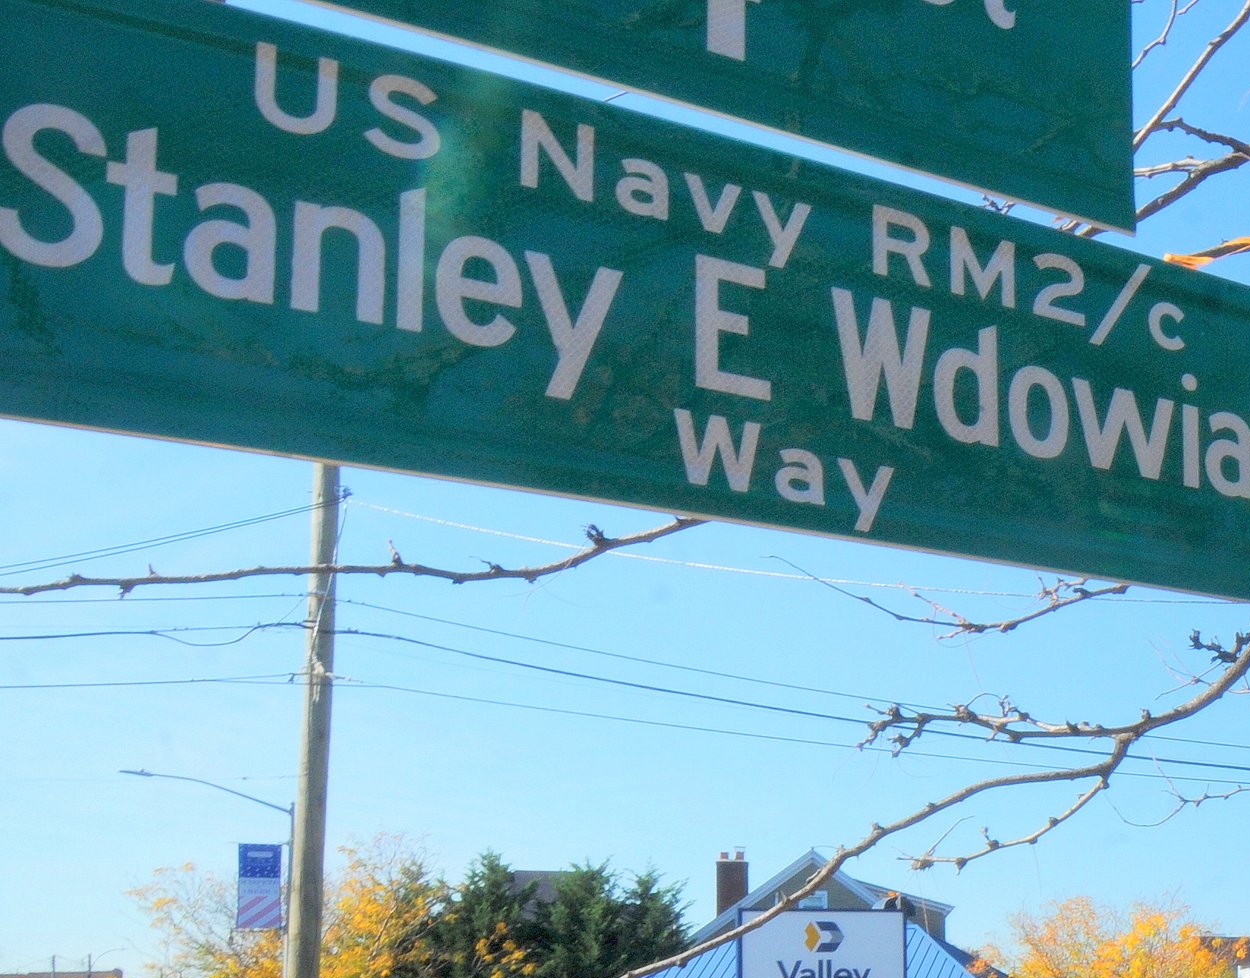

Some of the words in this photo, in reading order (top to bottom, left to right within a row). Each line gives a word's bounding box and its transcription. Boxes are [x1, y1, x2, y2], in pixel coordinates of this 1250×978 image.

[0, 103, 622, 400] Stanley
[695, 255, 771, 401] E
[254, 41, 440, 160] US
[519, 109, 811, 269] Navy
[872, 204, 1186, 350] RM2/c
[674, 409, 894, 532] Way
